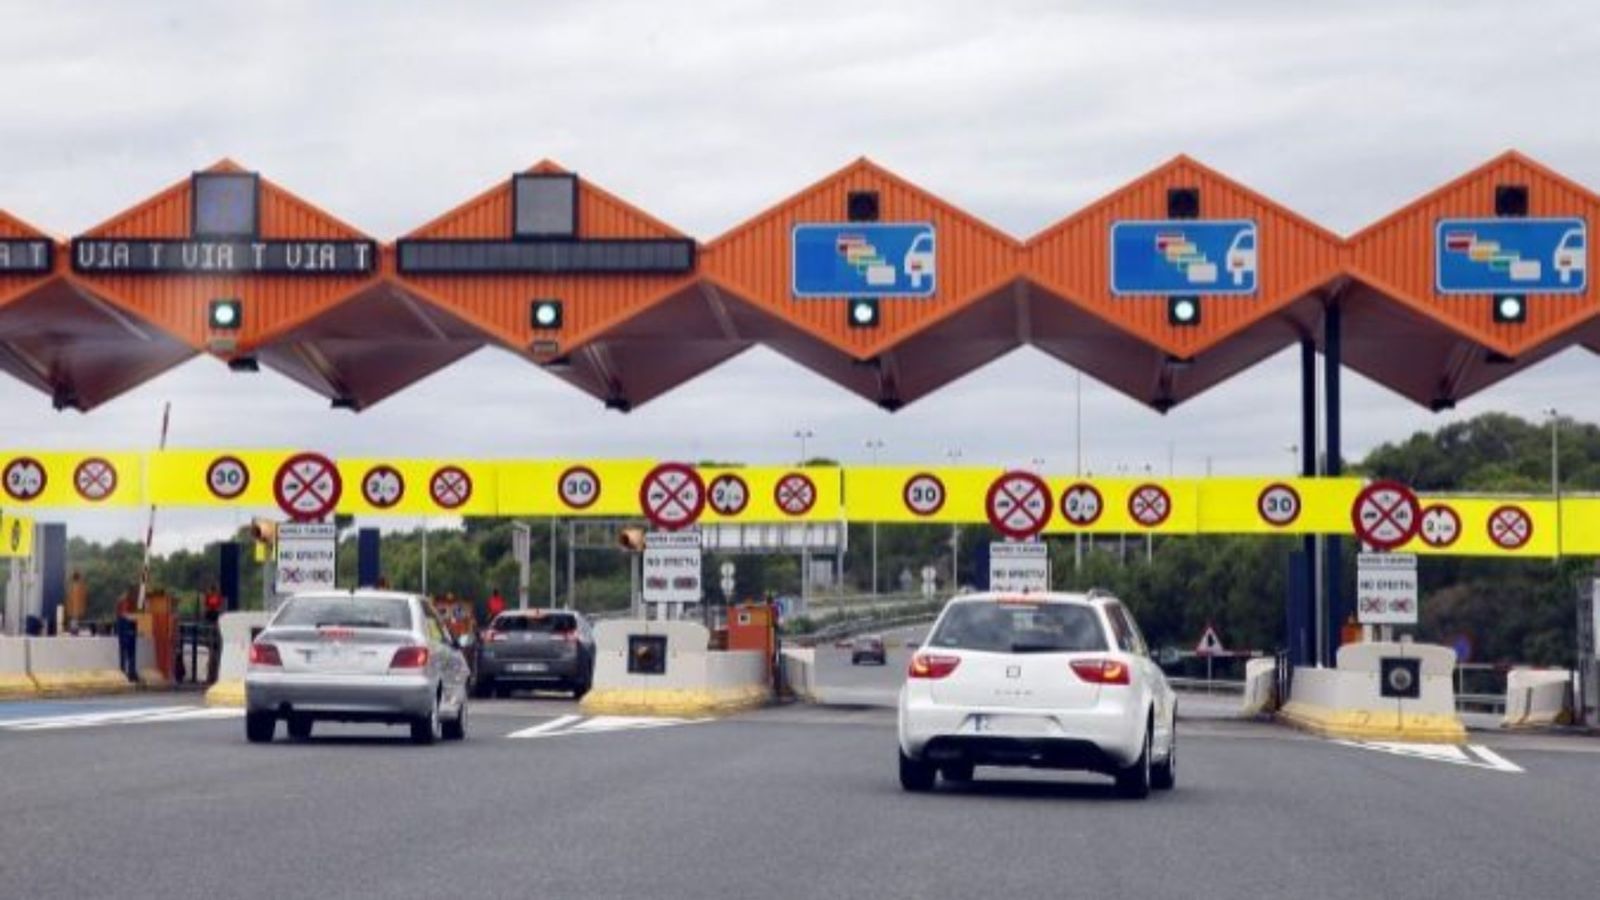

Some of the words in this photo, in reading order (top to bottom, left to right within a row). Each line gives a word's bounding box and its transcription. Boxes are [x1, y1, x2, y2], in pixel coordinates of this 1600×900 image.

[148, 243, 164, 269] T
[181, 243, 234, 270] VIA
[251, 243, 267, 270] T
[286, 242, 335, 270] VIA
[353, 243, 370, 270] T
[215, 470, 241, 485] 30
[566, 480, 592, 495] 30
[912, 487, 936, 502] 30
[1267, 497, 1292, 512] 30
